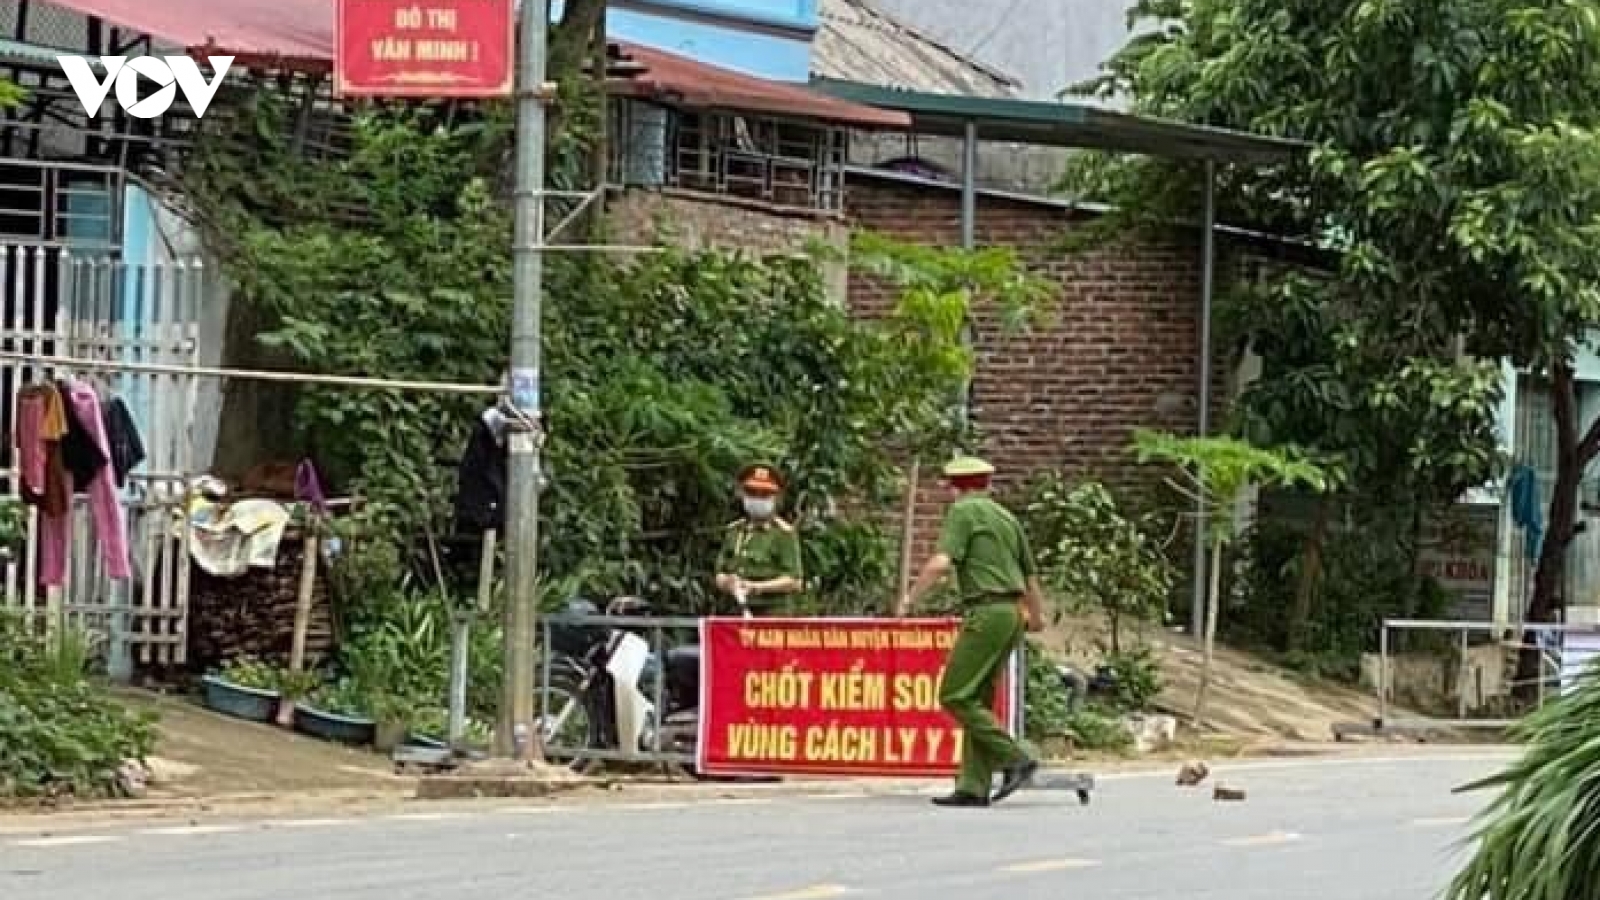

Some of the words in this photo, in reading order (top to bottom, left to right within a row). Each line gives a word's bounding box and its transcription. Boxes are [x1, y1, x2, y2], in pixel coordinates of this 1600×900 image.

[415, 39, 468, 62] MINH
[745, 659, 813, 709] CHỐT
[821, 659, 885, 710] KIỂM
[893, 665, 946, 712] SO
[727, 717, 797, 760] VÙNG
[805, 719, 876, 761] CÁCH
[884, 726, 918, 763] LY
[925, 726, 944, 763] Y
[951, 727, 964, 763] T
